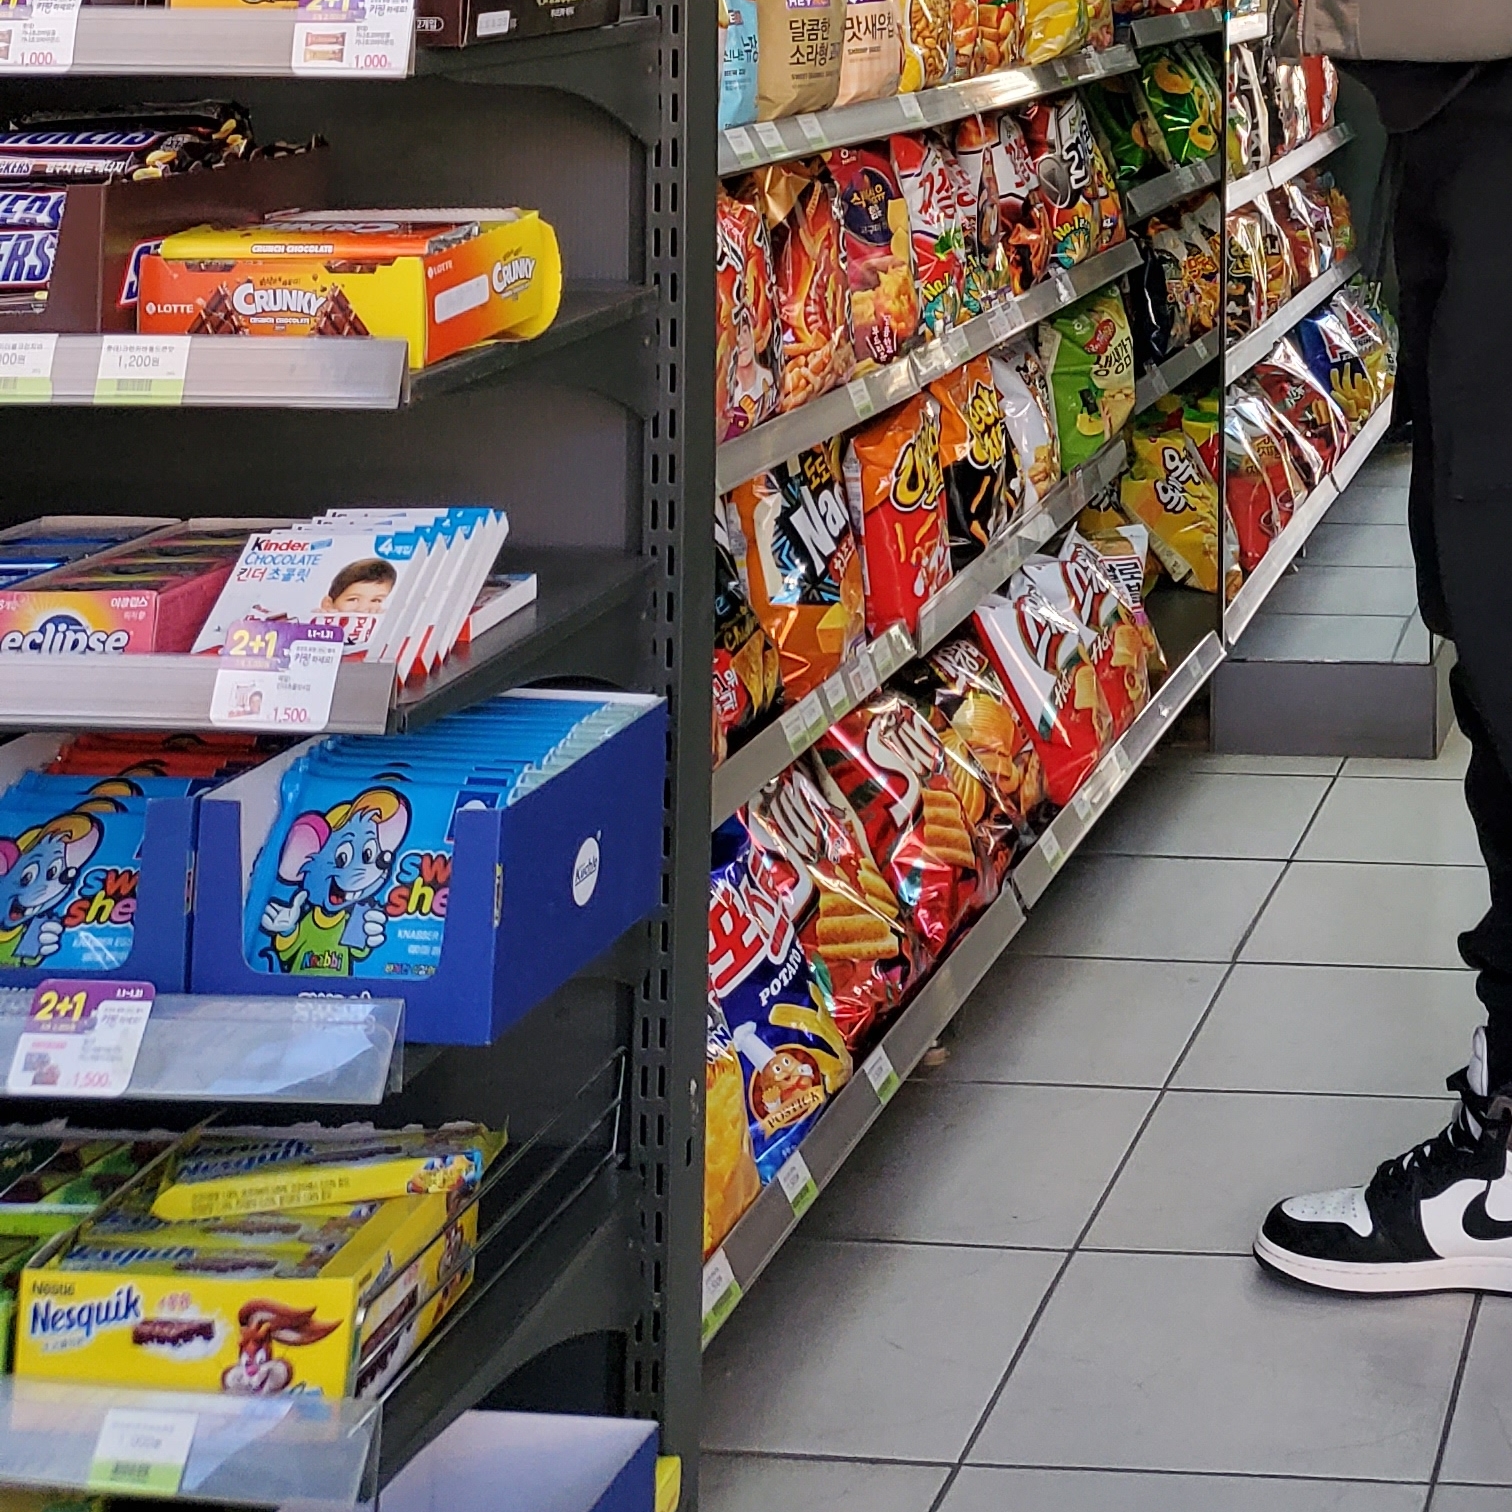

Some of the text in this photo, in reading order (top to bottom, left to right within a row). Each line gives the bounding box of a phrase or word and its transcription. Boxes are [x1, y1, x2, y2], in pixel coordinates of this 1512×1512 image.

[789, 18, 830, 43] 달콤한
[19, 51, 53, 66] 1,000
[354, 53, 388, 69] 1,000
[285, 243, 334, 254] CHOCOLATE
[491, 257, 537, 294] CRUNKY
[156, 302, 194, 315] LOTTE
[233, 281, 329, 318] CRUNKY
[116, 355, 160, 368] 1,200원
[252, 537, 308, 552] Kinder
[244, 552, 322, 566] CHOCOLATE
[235, 566, 312, 584] 킨더 초콜릿
[1, 623, 131, 653] eclipse
[231, 629, 279, 658] 2+1
[272, 706, 307, 724] 1,500
[34, 990, 88, 1023] 2+1
[30, 1285, 143, 1336] Nesquik
